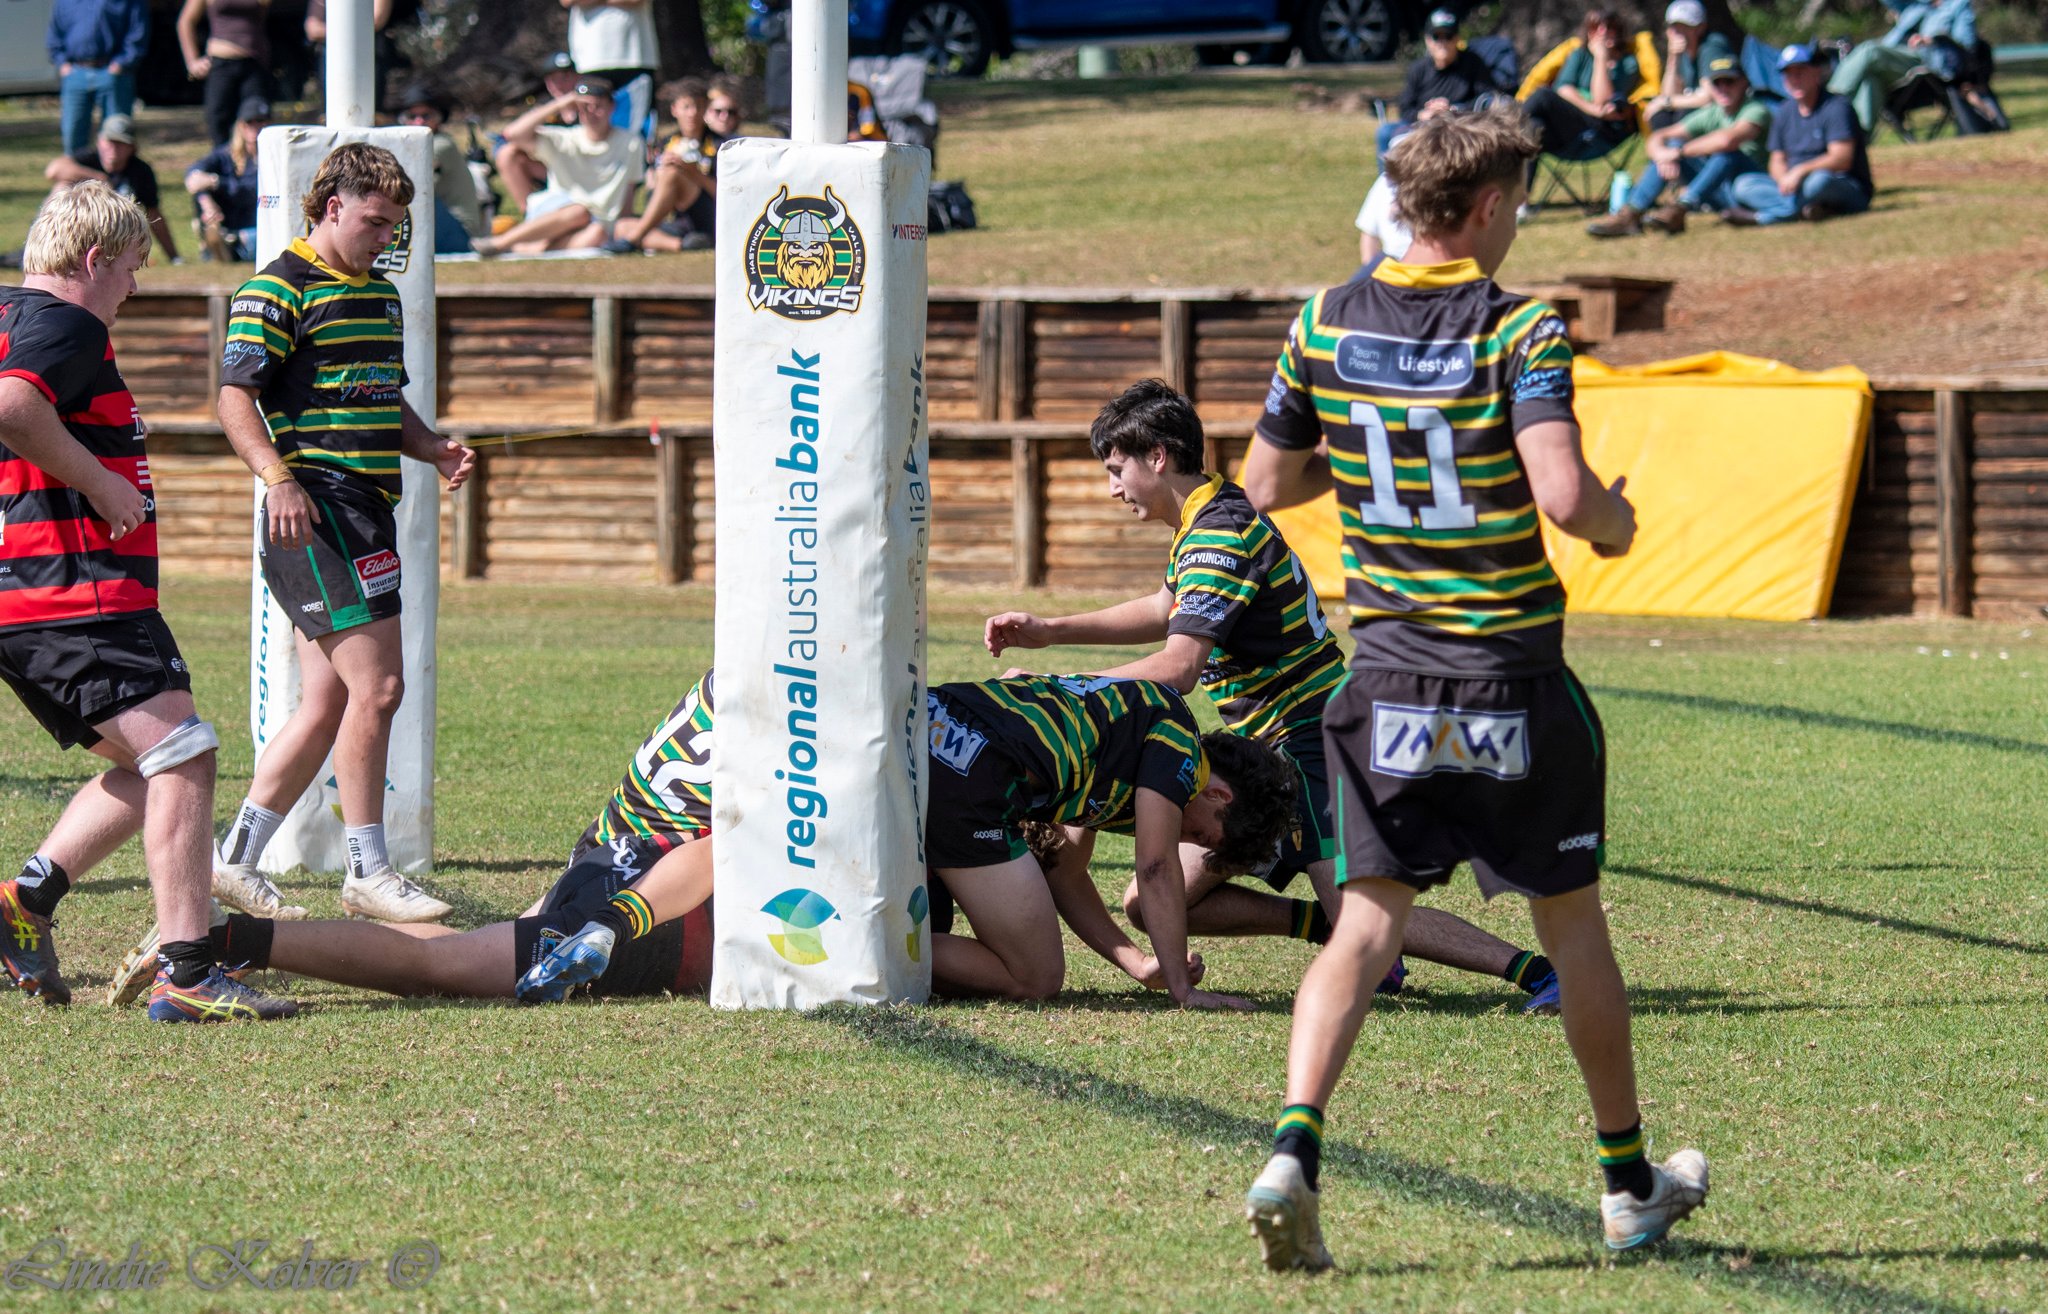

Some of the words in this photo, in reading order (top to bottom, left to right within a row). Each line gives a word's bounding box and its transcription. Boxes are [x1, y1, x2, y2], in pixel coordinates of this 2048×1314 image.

[750, 223, 766, 275] HASTINGS
[848, 226, 862, 274] VALLEY
[748, 284, 863, 312] VIKINGS
[1352, 345, 1380, 360] Team
[1350, 401, 1477, 530] 11
[367, 574, 400, 591] Insuranc
[635, 688, 712, 814] 12
[1558, 833, 1599, 850] GOOSE
